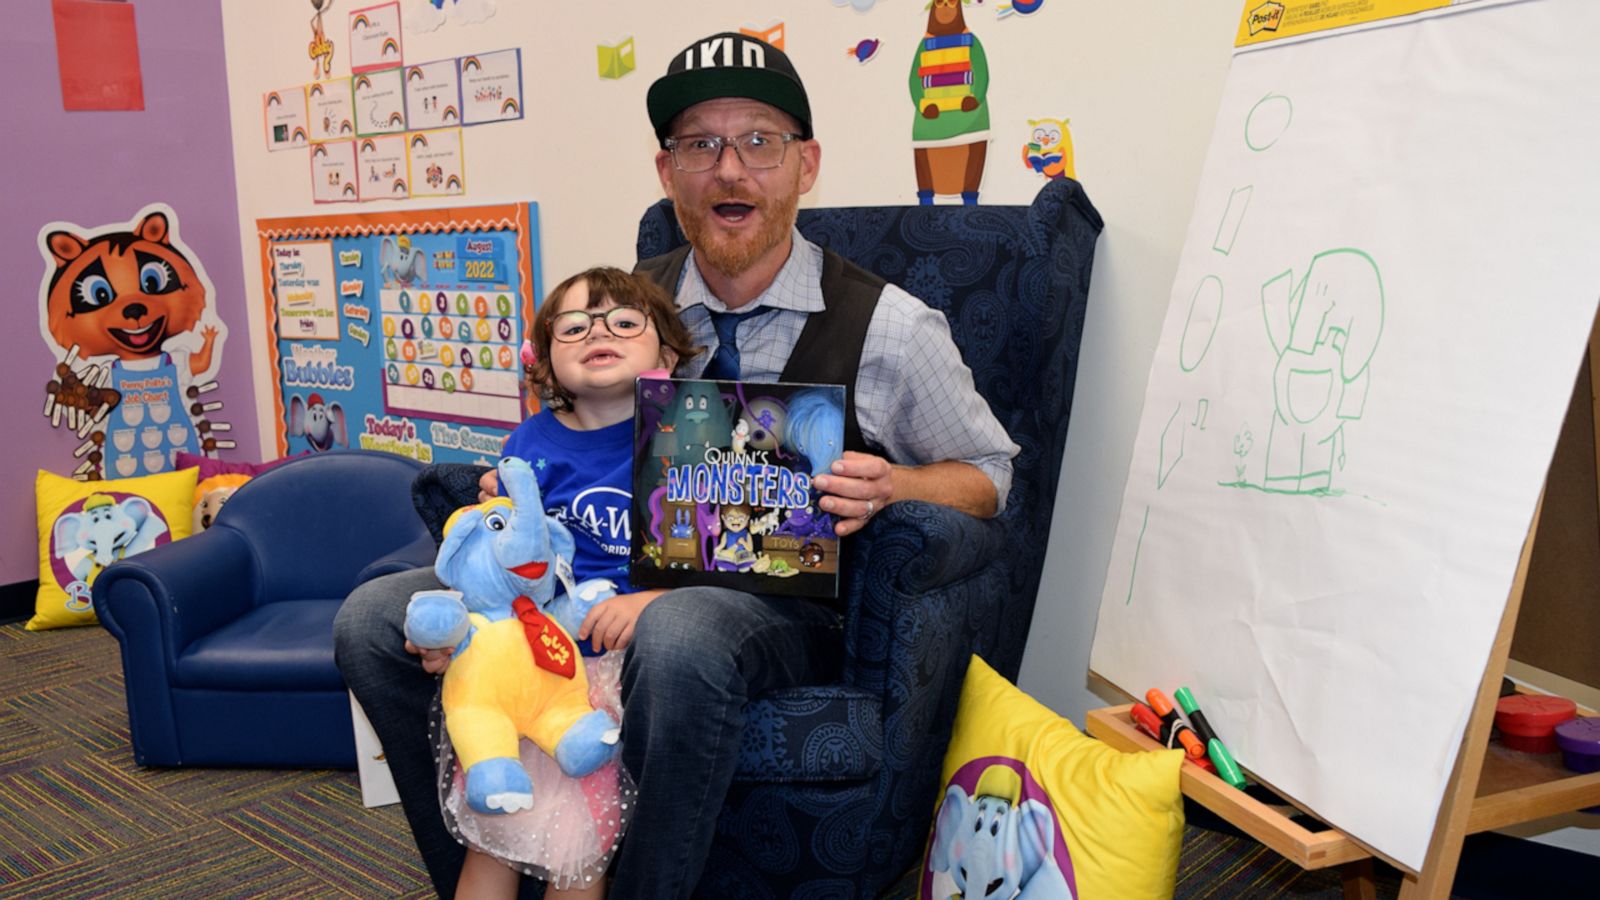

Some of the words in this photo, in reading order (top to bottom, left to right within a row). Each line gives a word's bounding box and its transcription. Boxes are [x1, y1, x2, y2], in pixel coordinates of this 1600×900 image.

[1251, 9, 1279, 24] Post-it
[466, 240, 493, 254] August
[466, 261, 494, 278] 2022
[285, 359, 352, 387] Bubbles
[143, 391, 168, 402] Chart
[366, 417, 414, 441] Today's
[431, 424, 459, 446] The
[704, 447, 769, 466] QUINN'S
[666, 463, 810, 509] MONSTERS
